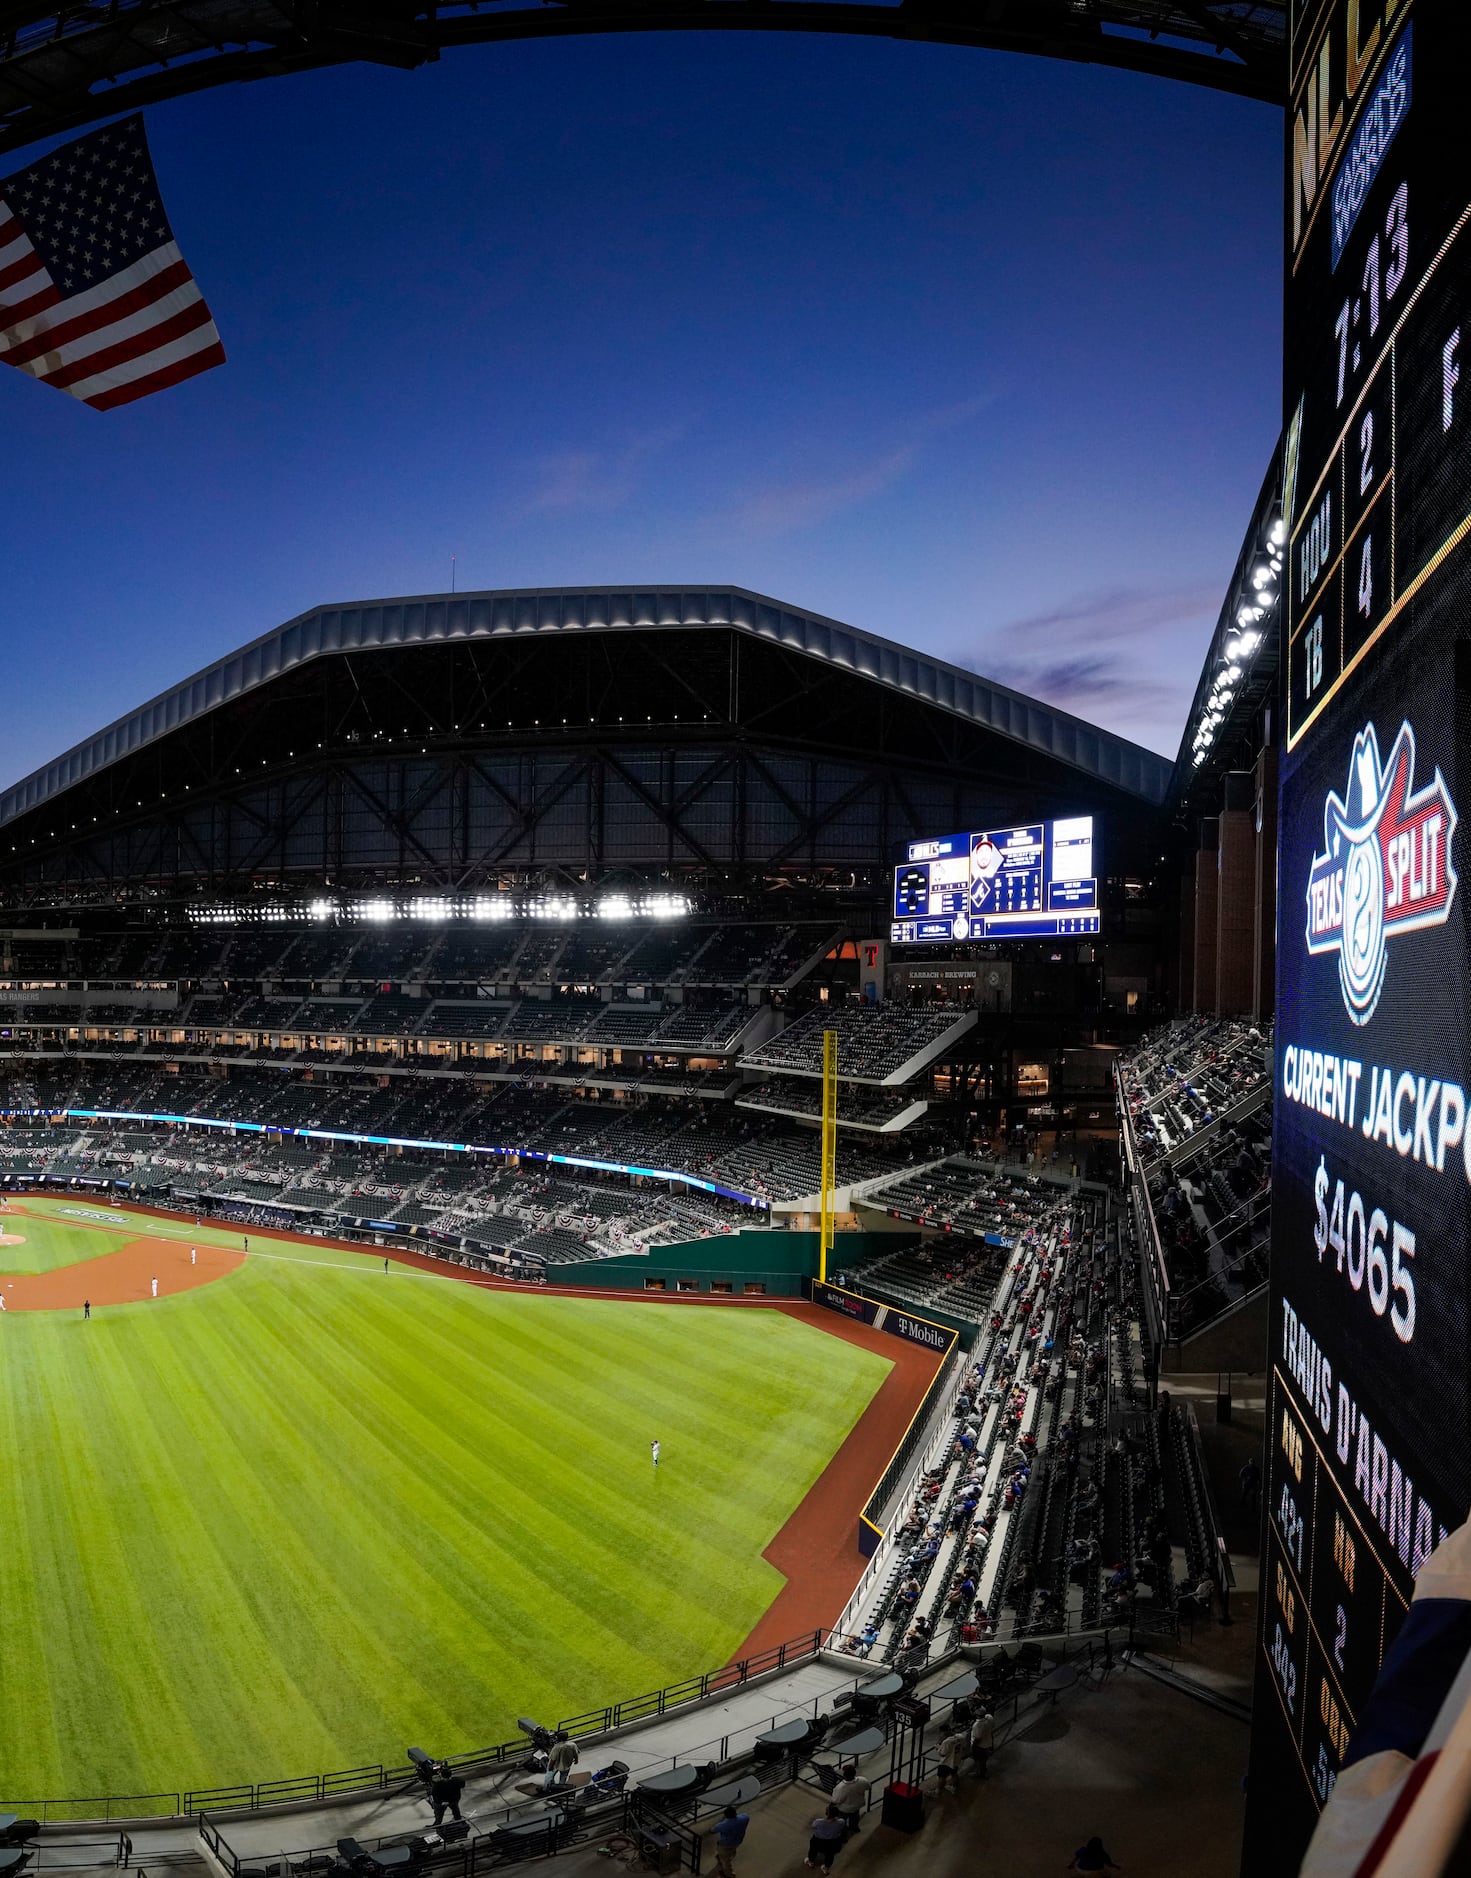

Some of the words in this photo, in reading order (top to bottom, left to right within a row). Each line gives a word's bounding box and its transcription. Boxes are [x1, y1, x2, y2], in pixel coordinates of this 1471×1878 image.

[1335, 180, 1408, 408] 7:13
[1443, 325, 1460, 434] F
[1301, 491, 1331, 603] HOU
[1360, 410, 1373, 496] 2
[1305, 614, 1323, 700] TB
[1359, 534, 1372, 619] 4
[1311, 868, 1343, 937] TEXAS
[1386, 814, 1442, 909] SPLIT
[9, 992, 40, 1001] RANGERS
[944, 971, 977, 979] BREWING
[1283, 1044, 1361, 1129] CURRENT
[1362, 1065, 1471, 1186] JACKP
[1314, 1153, 1416, 1343] $4065
[1282, 1408, 1303, 1484] AVG
[1283, 1297, 1331, 1435] TRAVIS
[1337, 1381, 1449, 1582] D'ARNA
[1278, 1483, 1304, 1574] .421
[1334, 1509, 1356, 1594] HR
[1277, 1560, 1294, 1635] SLG
[1335, 1603, 1347, 1673] 2
[895, 1711, 912, 1726] 135
